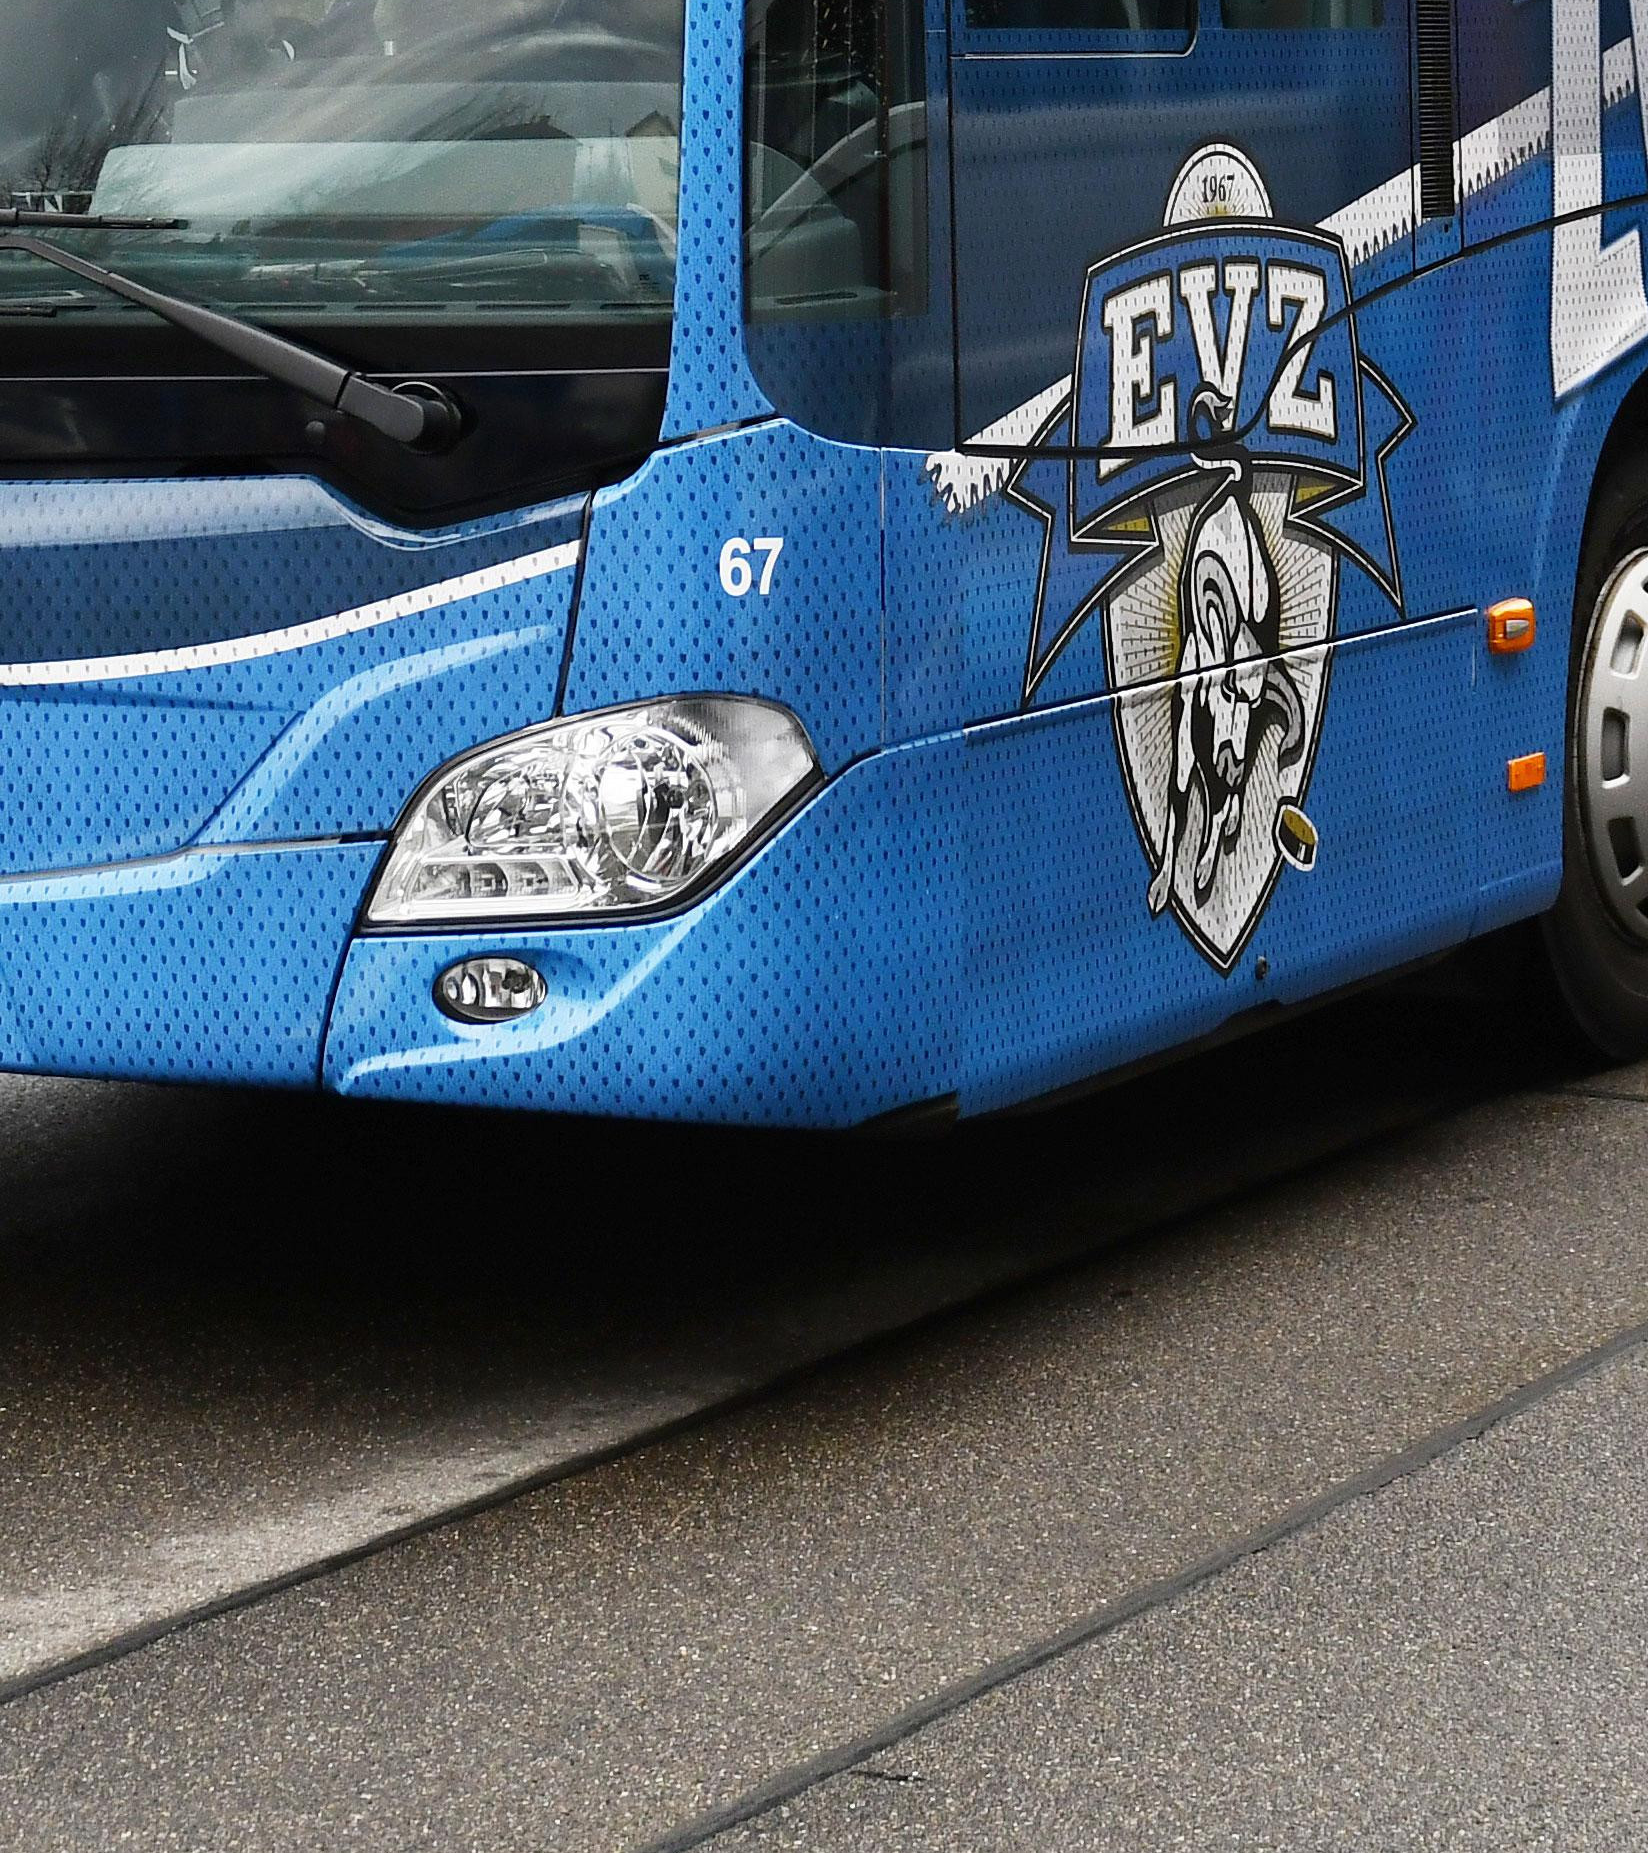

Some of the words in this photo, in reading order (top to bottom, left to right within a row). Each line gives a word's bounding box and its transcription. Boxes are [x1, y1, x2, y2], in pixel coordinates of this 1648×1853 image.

[1201, 173, 1236, 204] 1967
[1099, 258, 1337, 480] EVZ
[718, 536, 784, 597] 67
